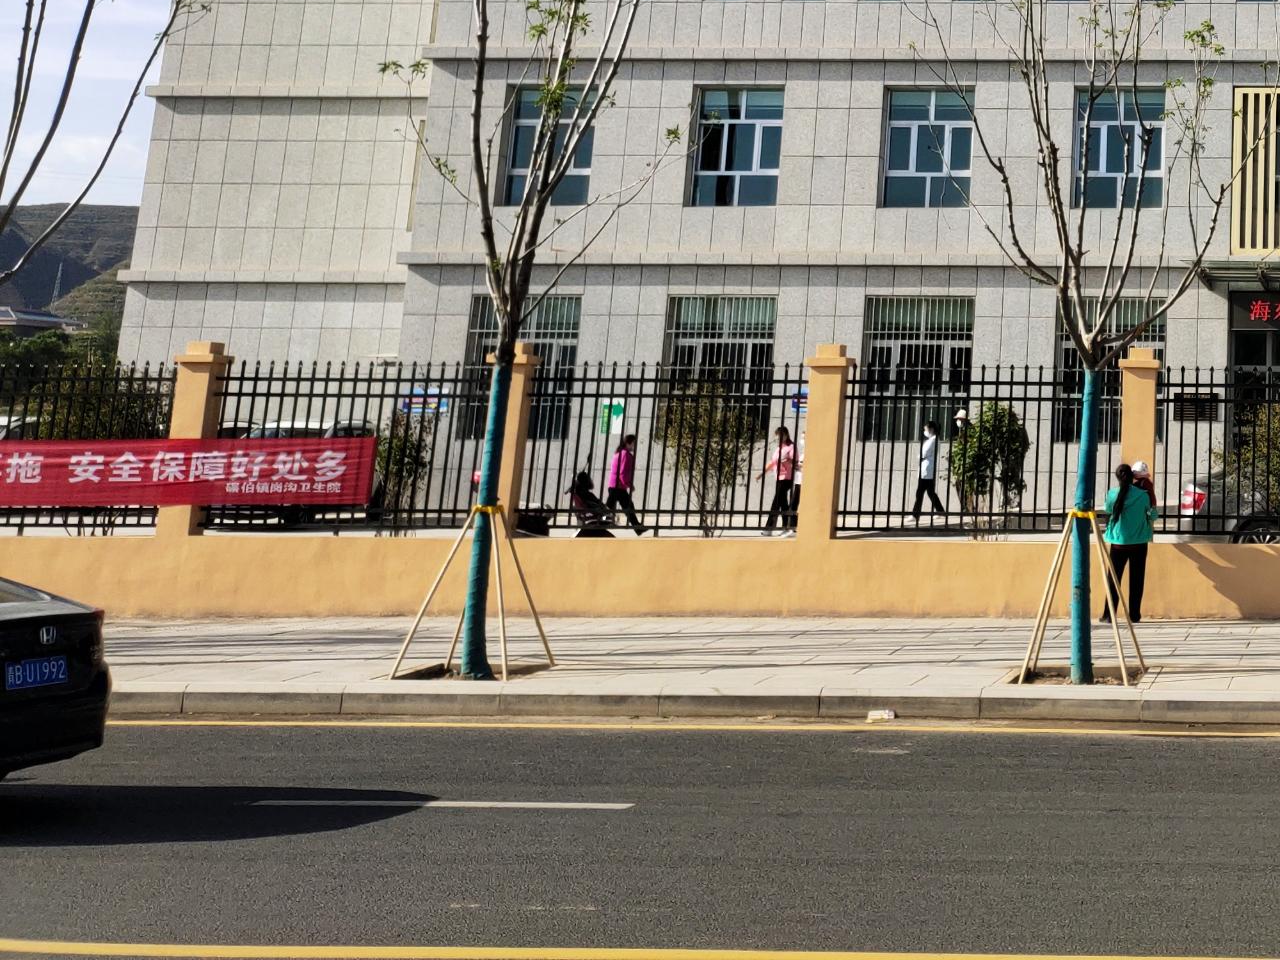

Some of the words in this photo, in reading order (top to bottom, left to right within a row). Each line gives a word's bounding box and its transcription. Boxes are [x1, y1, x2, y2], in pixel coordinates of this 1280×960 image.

[0, 451, 44, 484] 拖
[68, 450, 347, 483] 安全保障好处多
